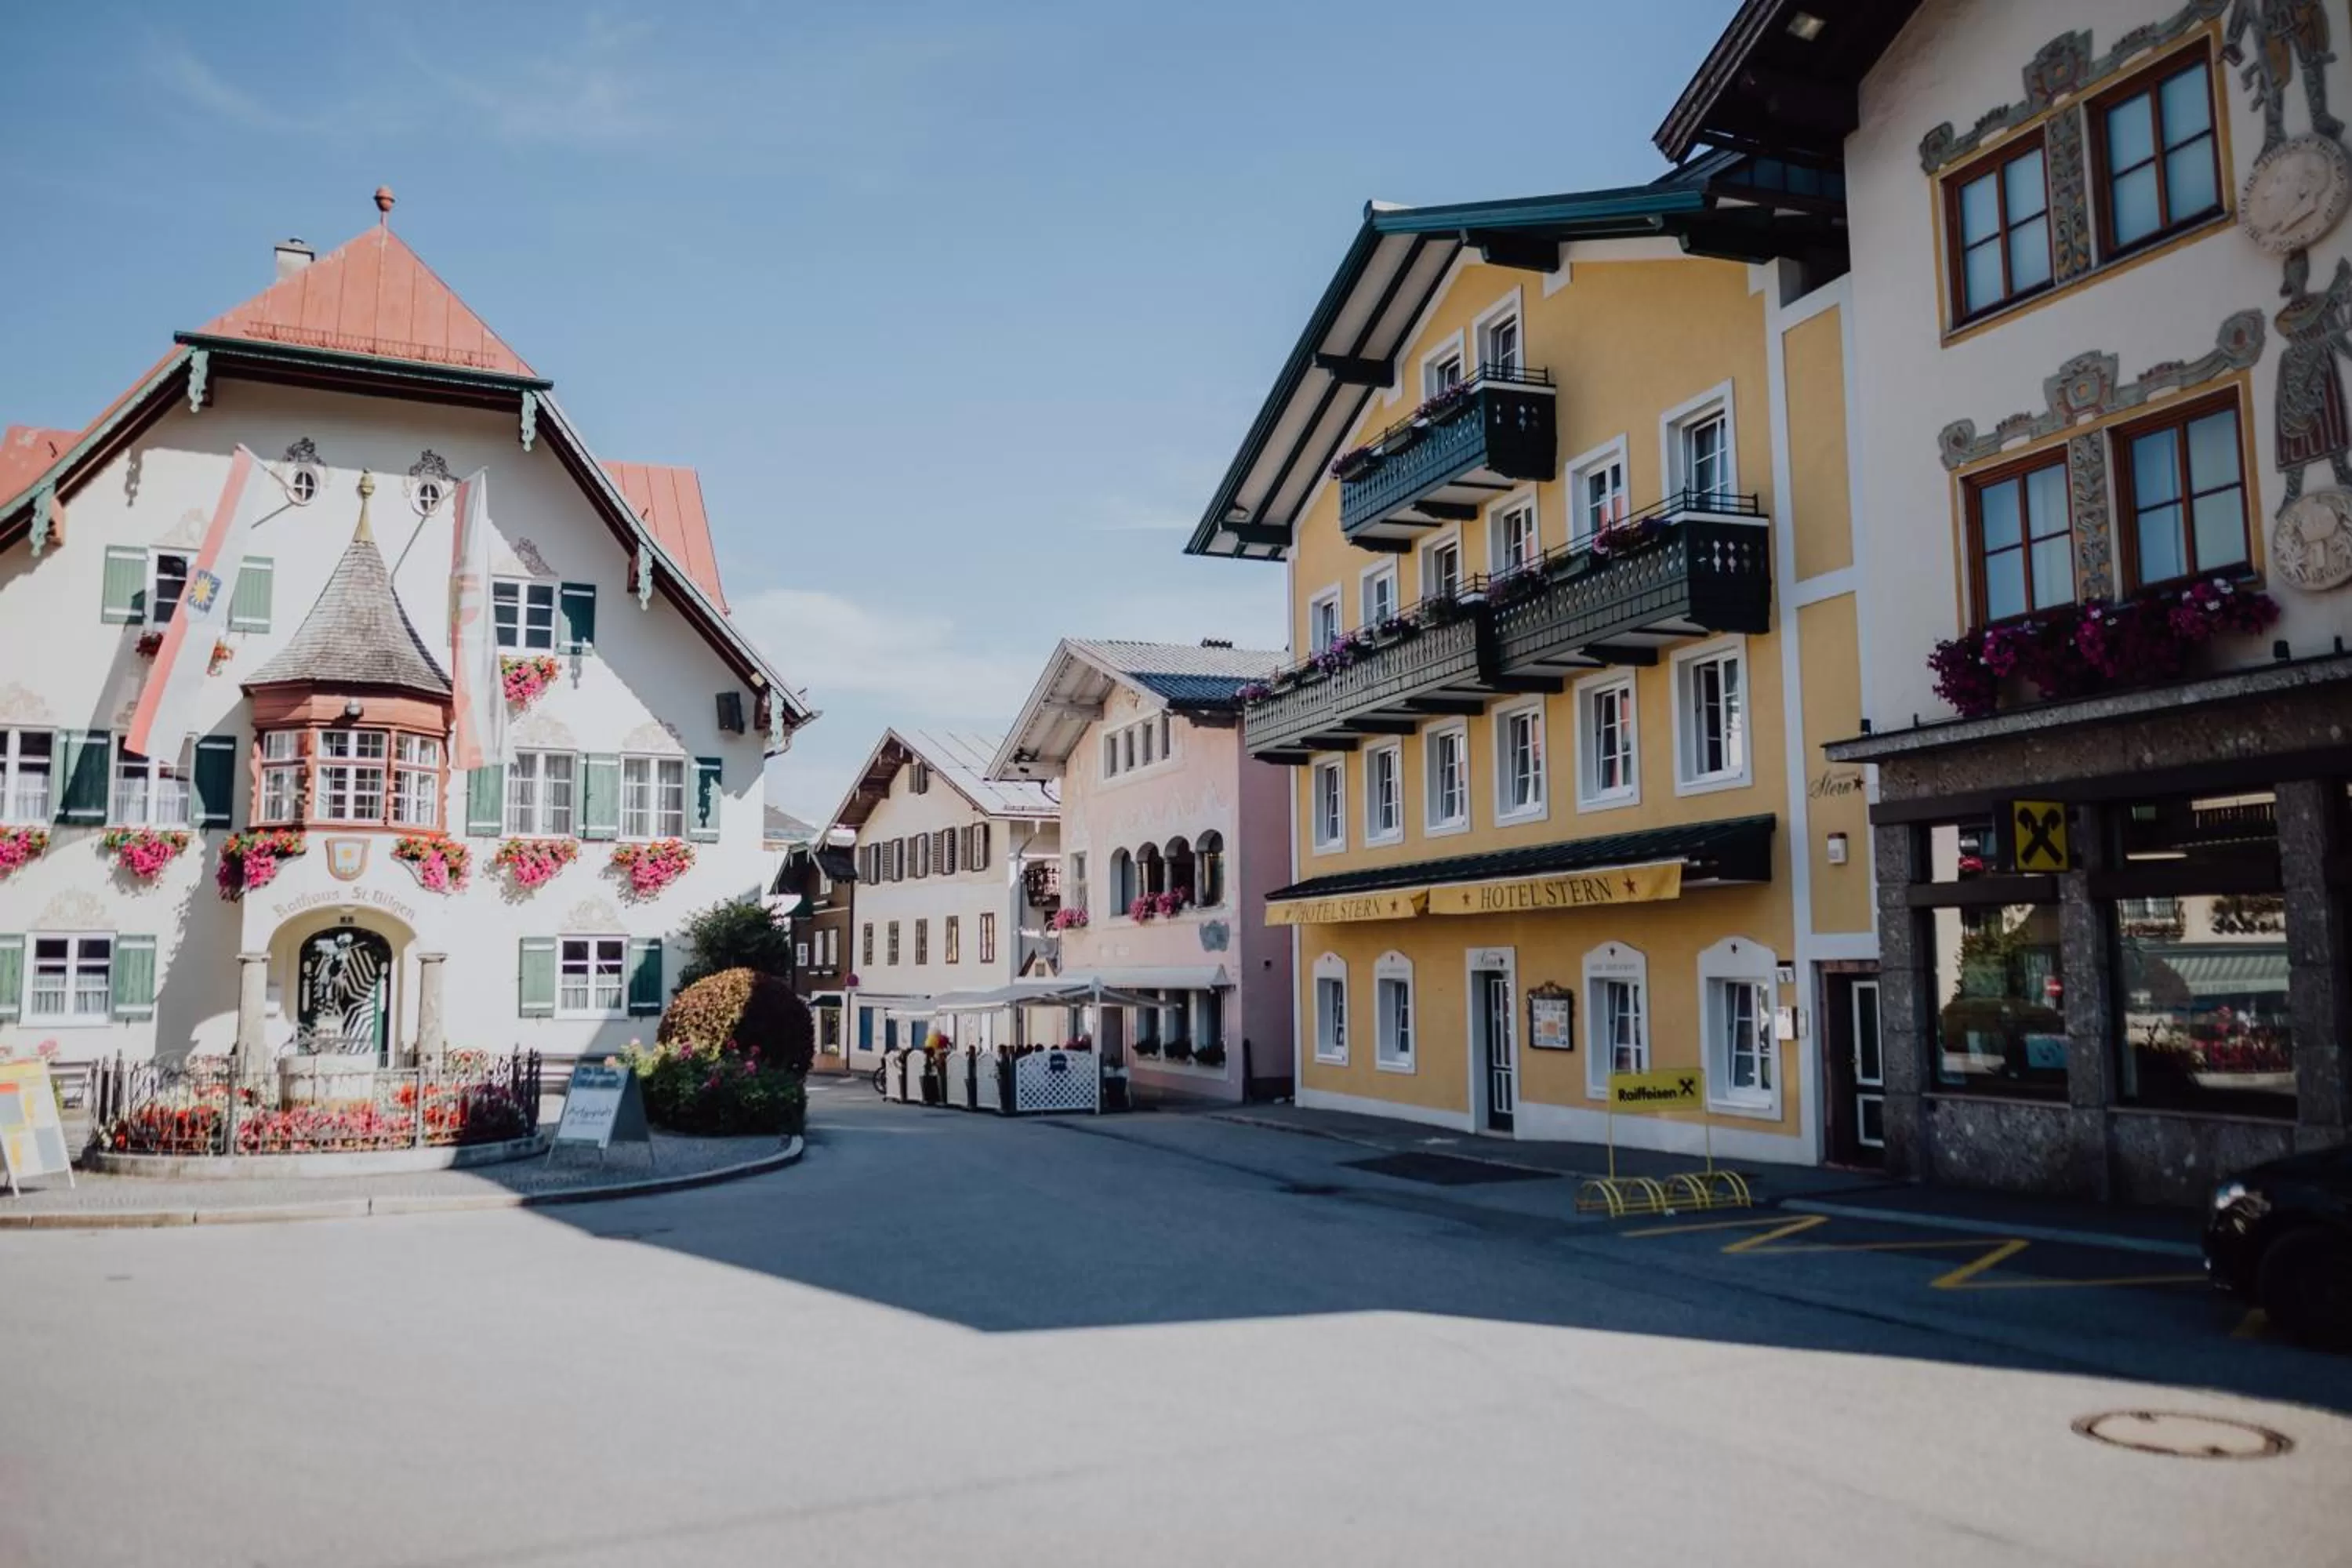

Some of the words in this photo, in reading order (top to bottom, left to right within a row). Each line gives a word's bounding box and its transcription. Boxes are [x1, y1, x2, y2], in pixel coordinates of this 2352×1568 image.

[1808, 769, 1851, 799] Stern
[273, 890, 339, 917] Rathaus
[1480, 884, 1541, 909] HOTEL
[1545, 877, 1613, 905] STERN
[1340, 898, 1381, 919] STERN
[1617, 1085, 1677, 1102] Raiffeisen
